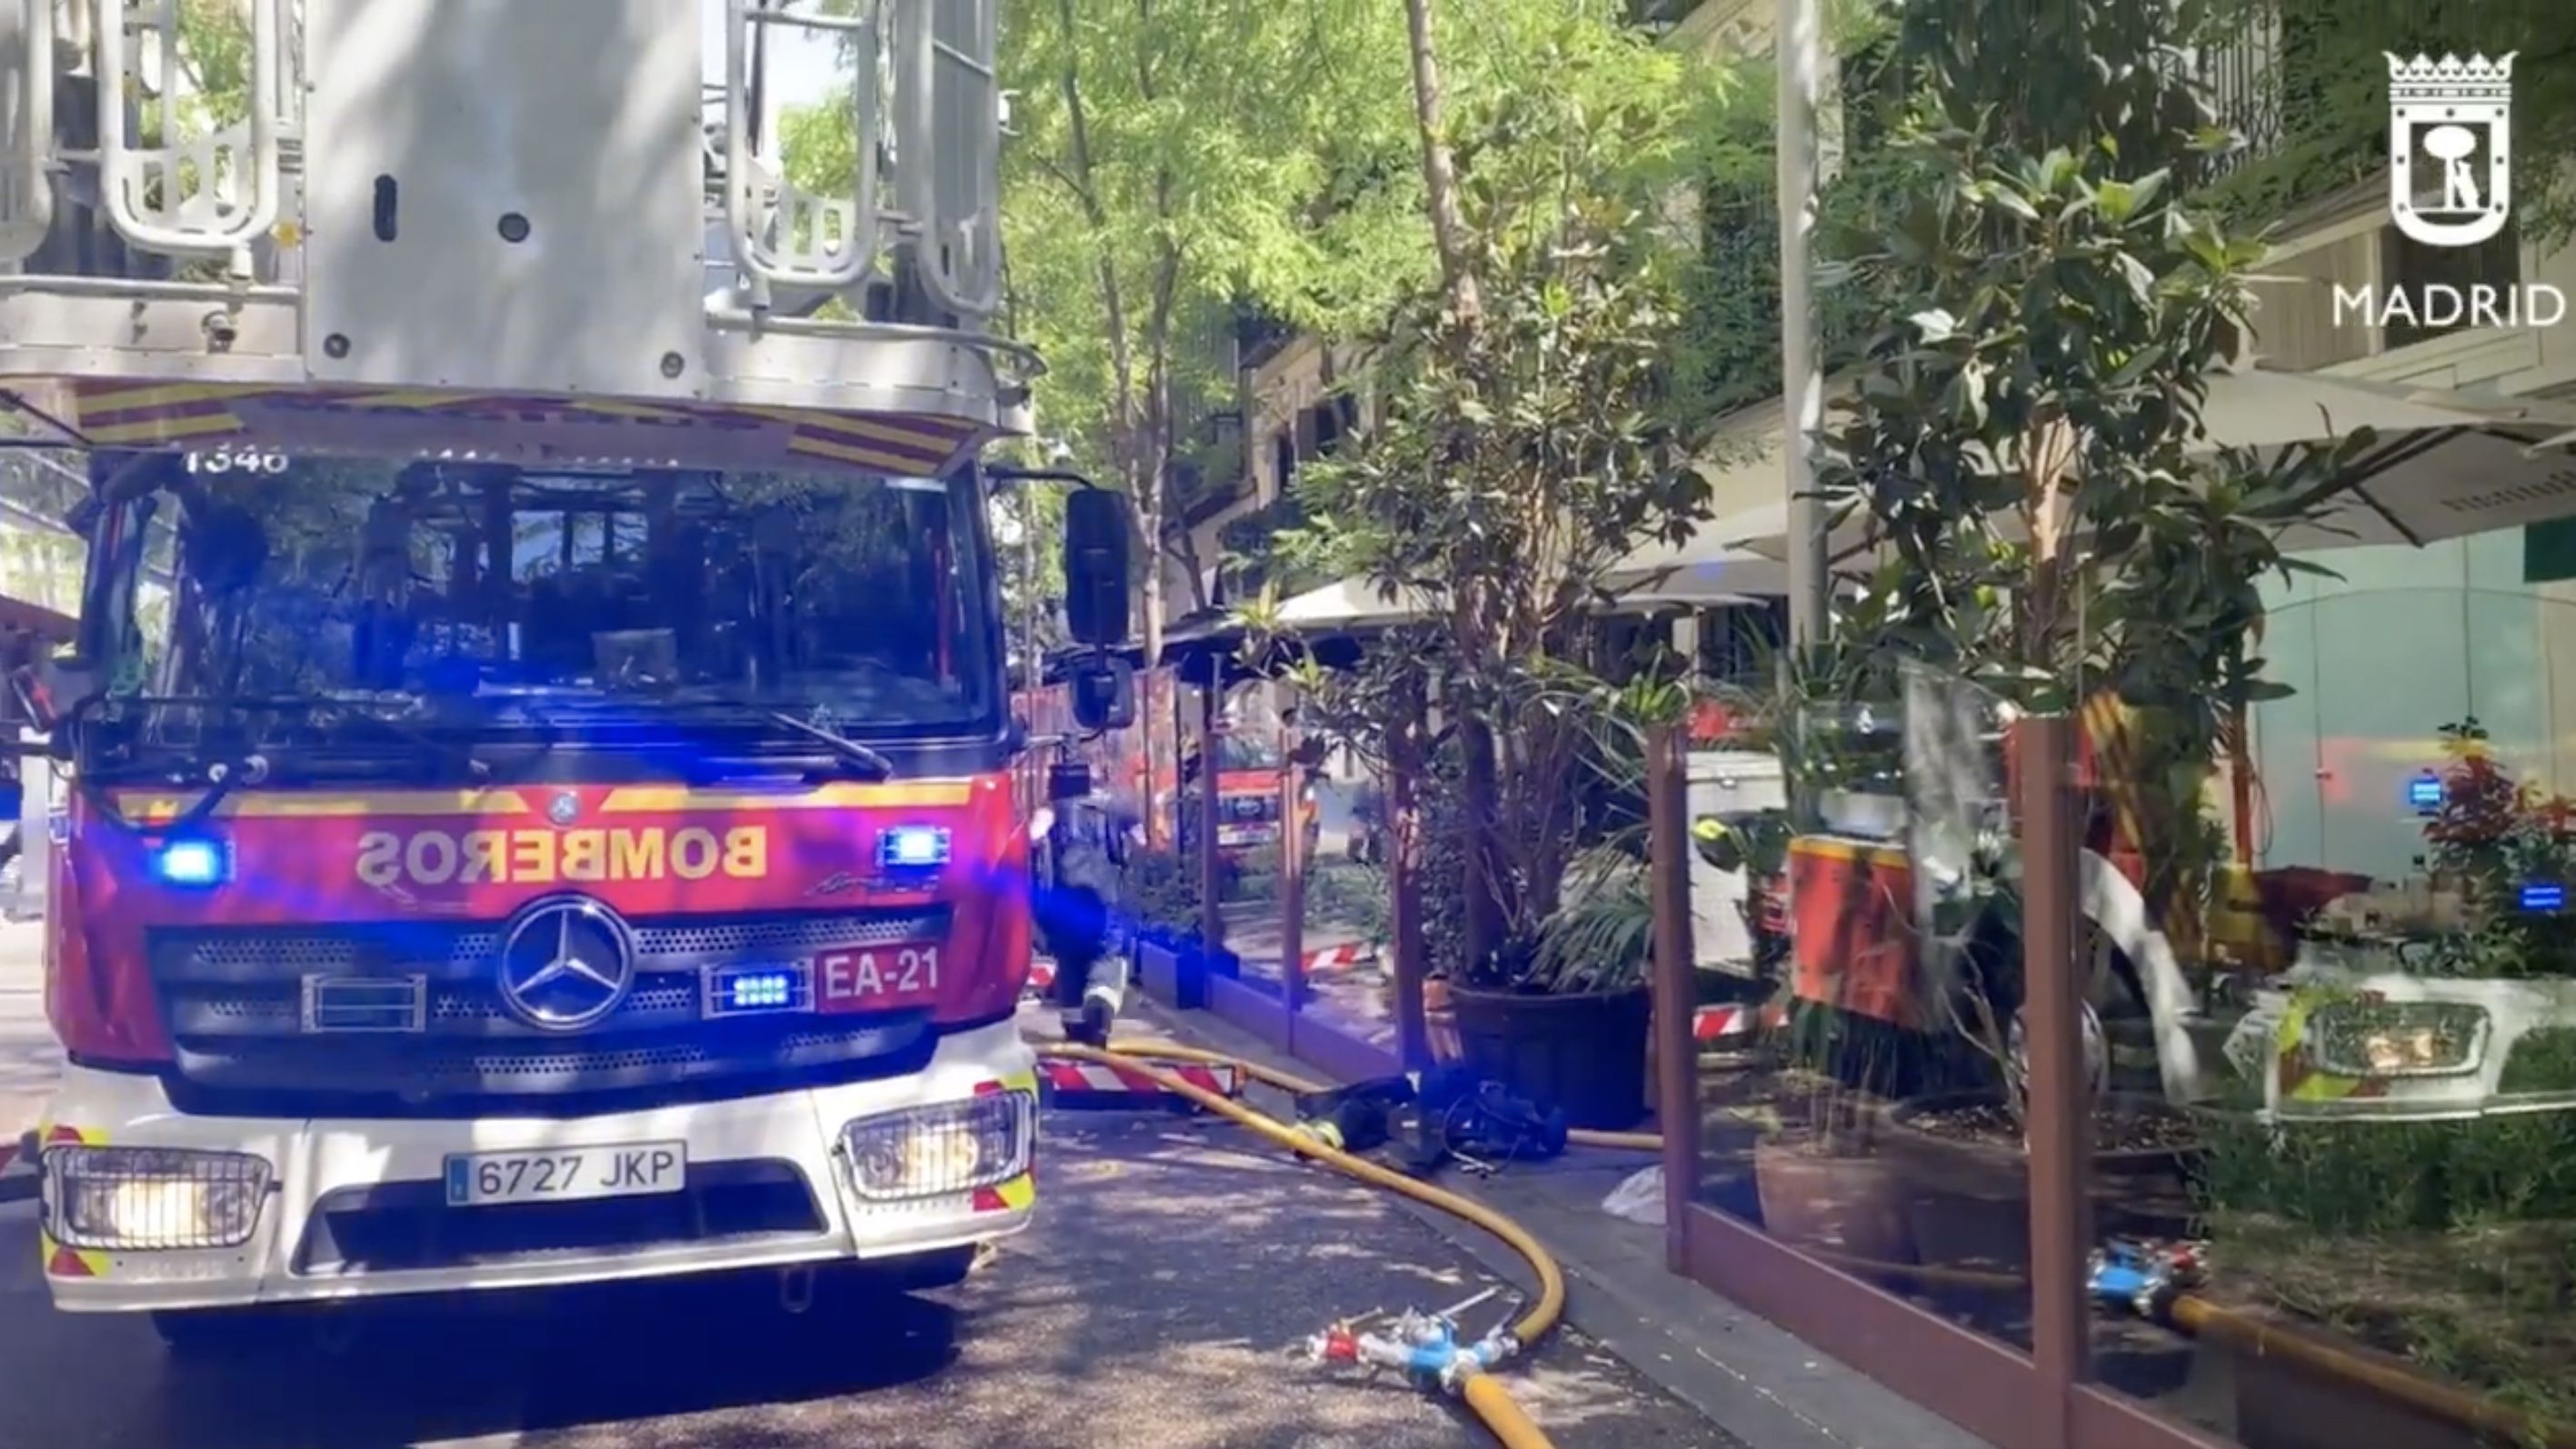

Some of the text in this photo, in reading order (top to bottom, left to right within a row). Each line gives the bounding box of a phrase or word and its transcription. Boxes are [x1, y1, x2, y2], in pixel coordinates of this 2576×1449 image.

[824, 946, 939, 999] EA-21
[477, 1149, 674, 1195] 6727 JKP
